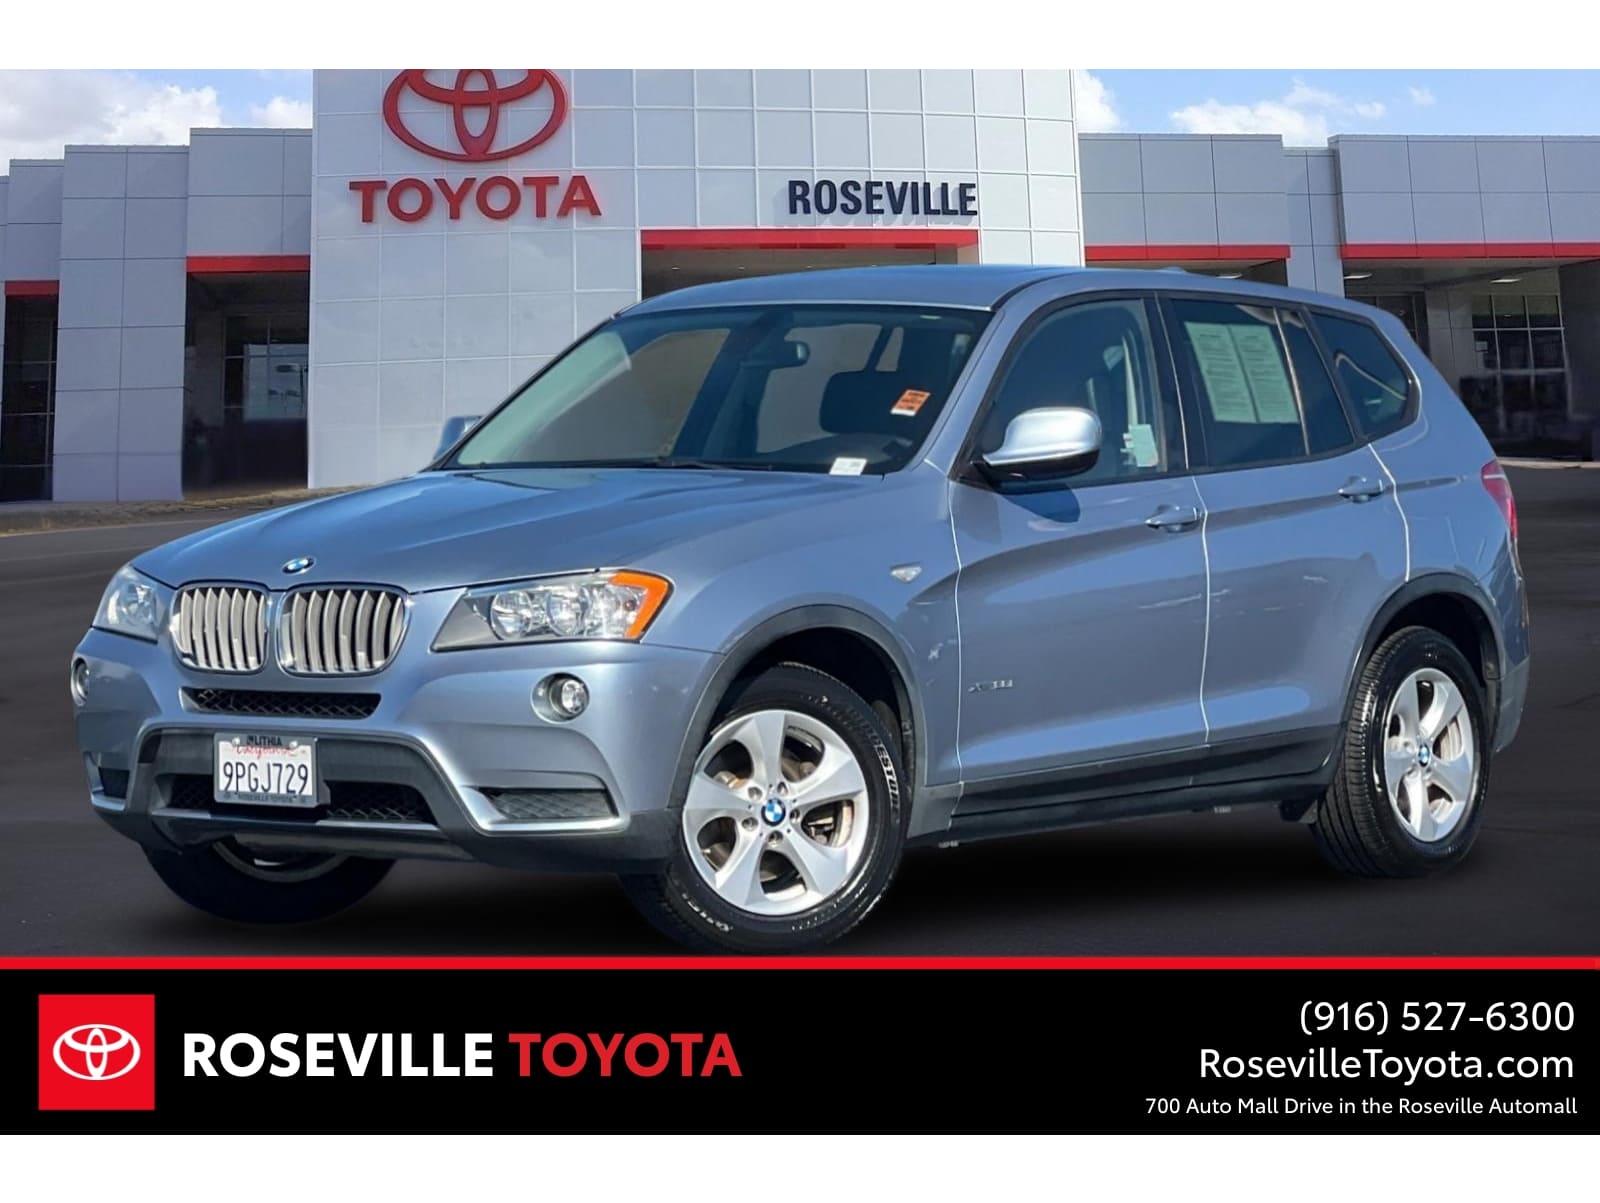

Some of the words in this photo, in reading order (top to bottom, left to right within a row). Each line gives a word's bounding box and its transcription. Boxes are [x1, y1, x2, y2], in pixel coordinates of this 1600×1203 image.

[349, 175, 602, 222] TOYOTA
[788, 180, 978, 216] ROSEVILLE
[223, 761, 309, 794] 9PGJ729
